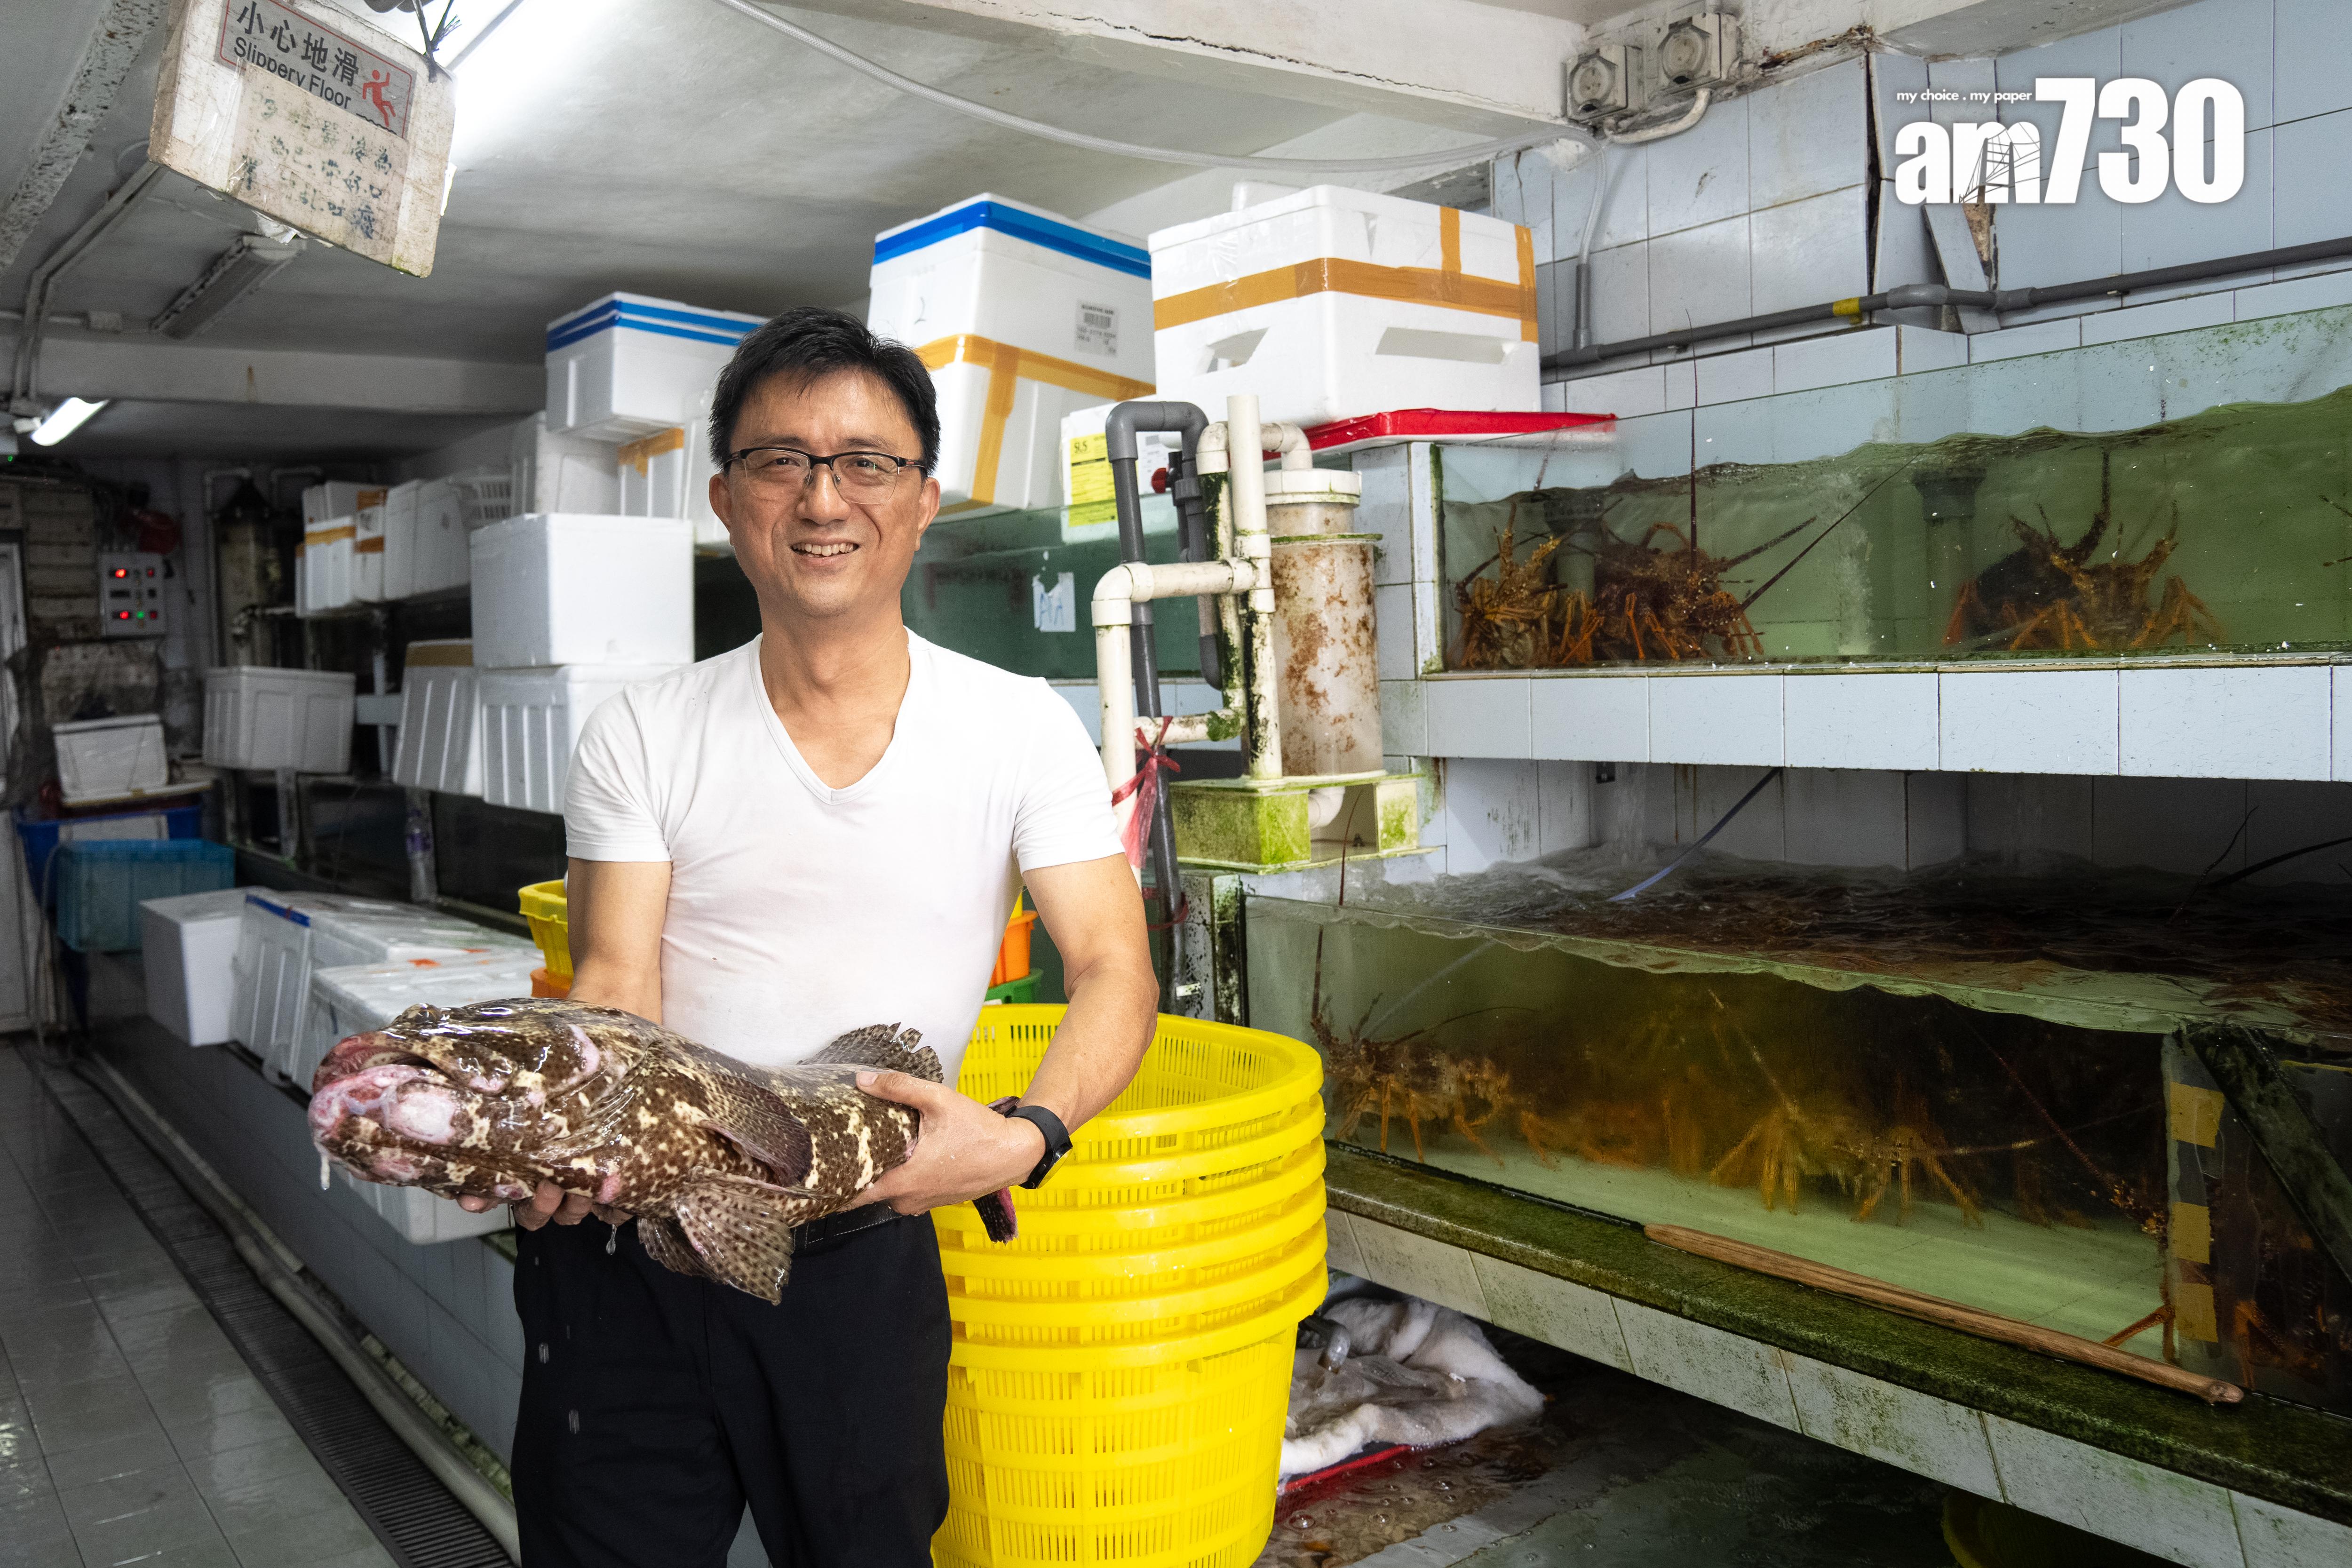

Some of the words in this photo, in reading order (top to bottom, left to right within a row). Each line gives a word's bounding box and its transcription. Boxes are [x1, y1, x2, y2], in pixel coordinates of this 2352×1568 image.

[234, 37, 306, 87] Slippery
[309, 73, 351, 109] Floor
[237, 1, 359, 87] 小心地滑
